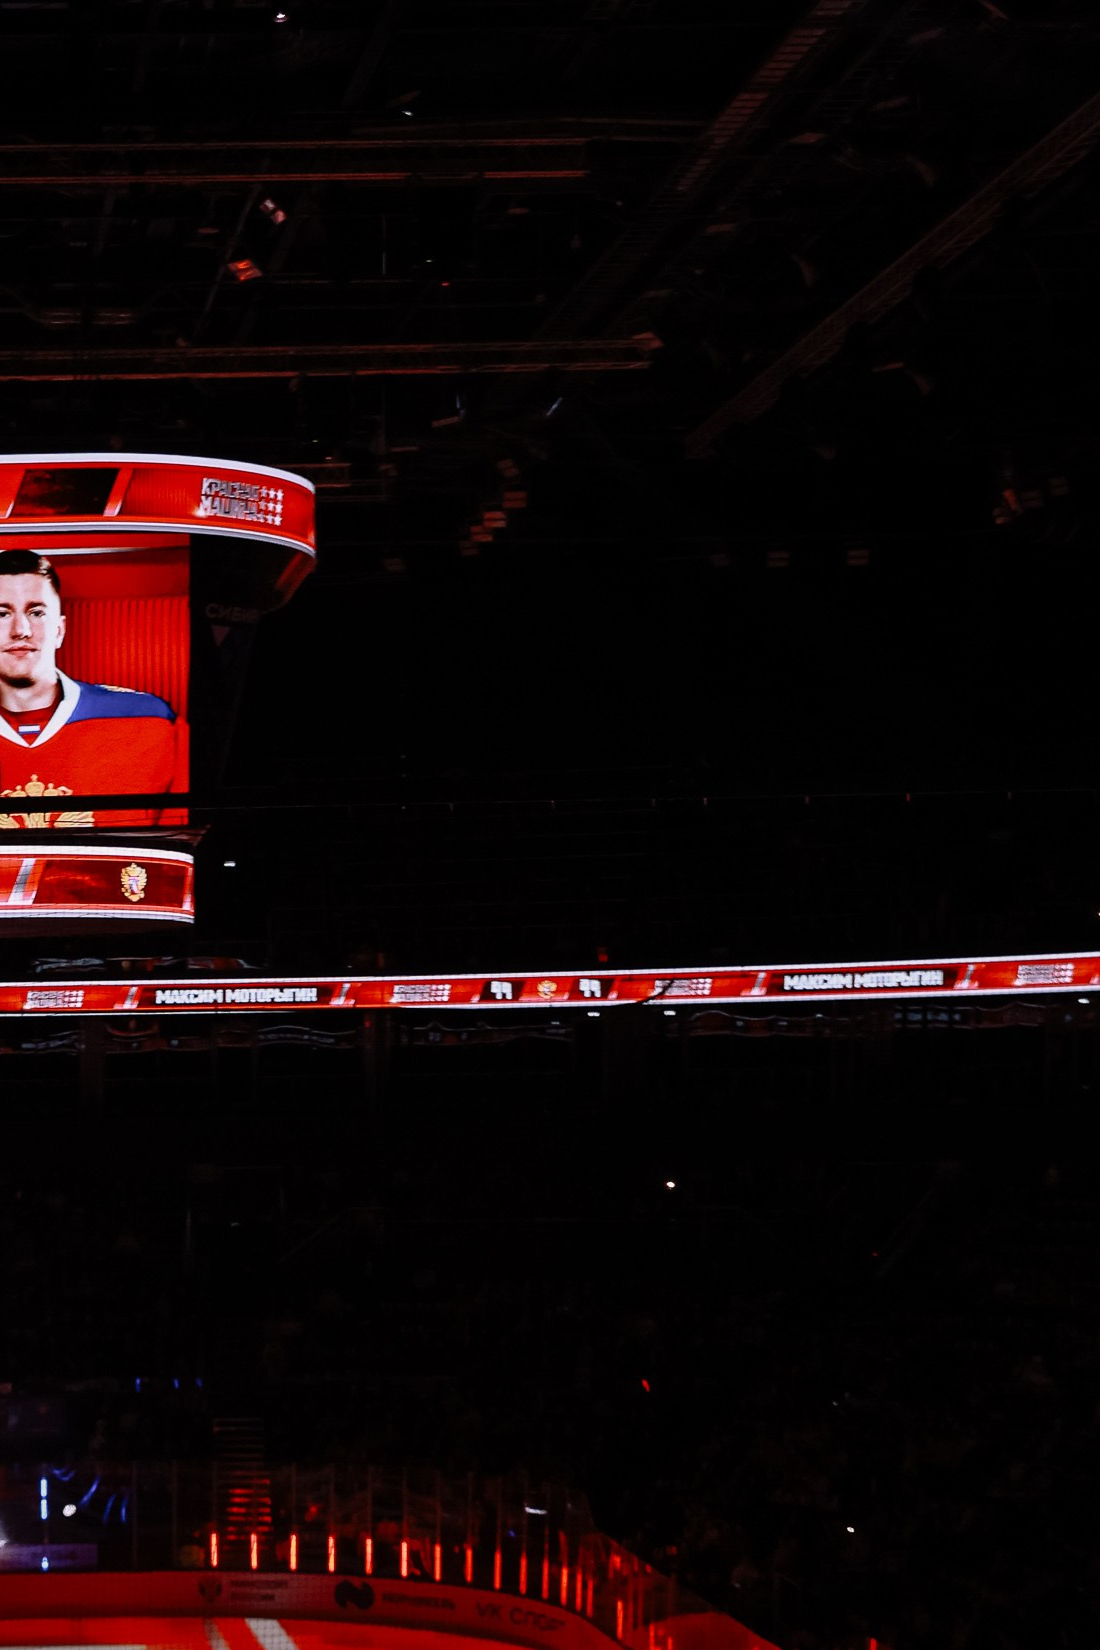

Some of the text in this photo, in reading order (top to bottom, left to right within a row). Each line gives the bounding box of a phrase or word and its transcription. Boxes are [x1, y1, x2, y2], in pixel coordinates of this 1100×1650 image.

[783, 970, 944, 991] МАКСИМ МОТОРЫГИН
[155, 987, 317, 1005] МАКСИМ МОТОРЫГИН
